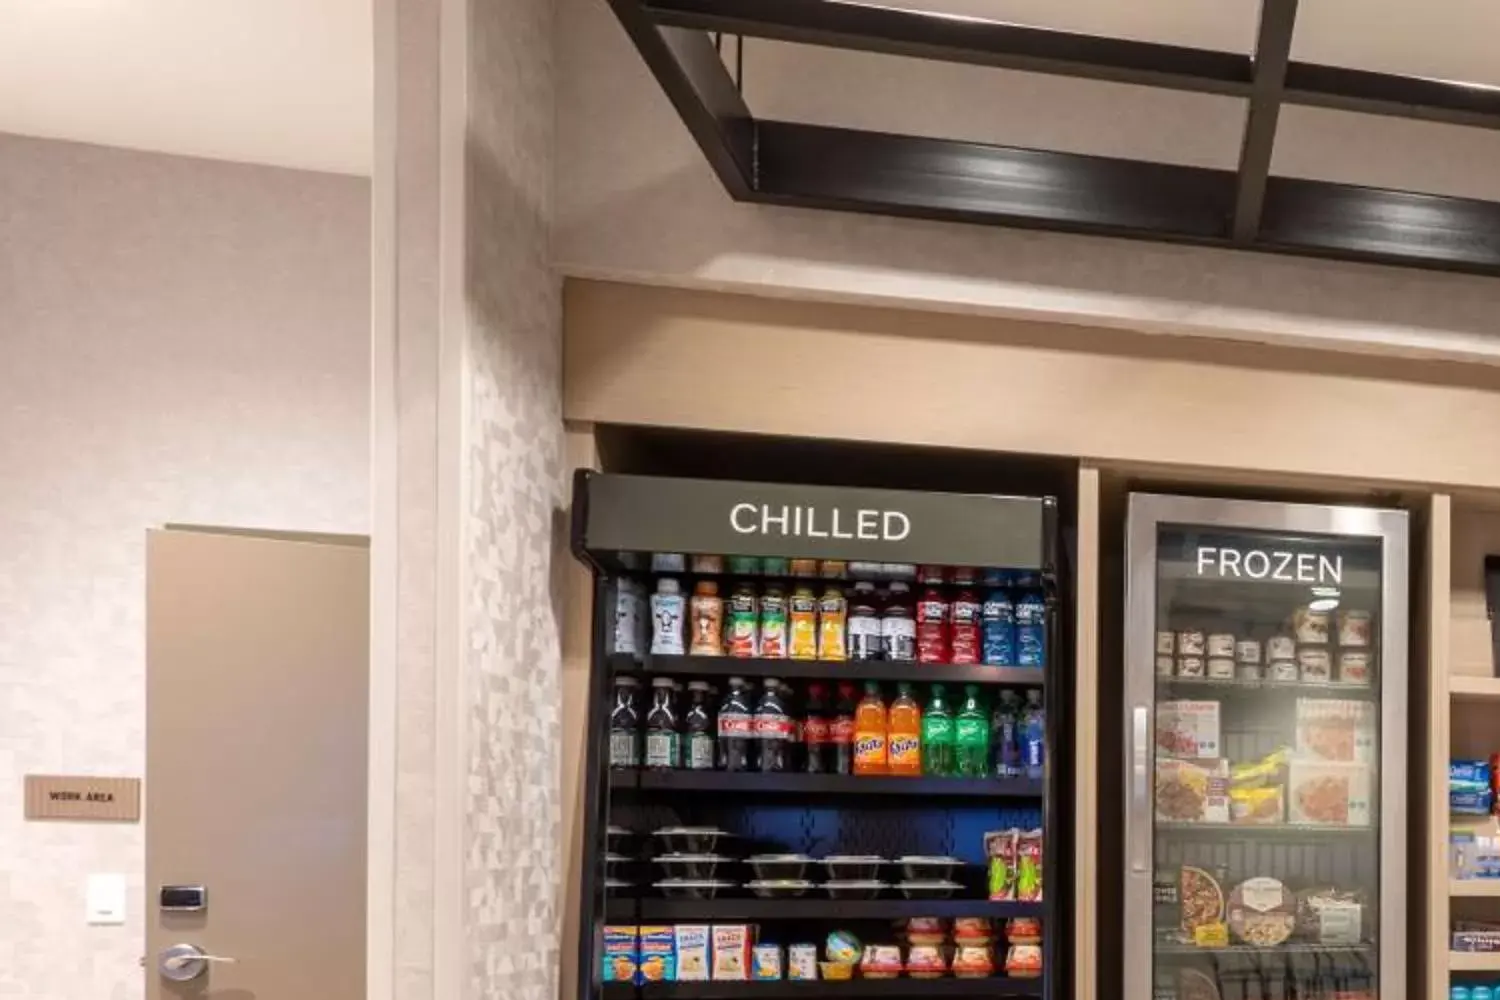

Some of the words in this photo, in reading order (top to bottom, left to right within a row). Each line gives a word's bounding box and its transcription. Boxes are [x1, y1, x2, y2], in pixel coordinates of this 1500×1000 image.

[729, 502, 911, 541] CHILLED
[1196, 546, 1343, 584] FROZEN
[49, 791, 82, 801] WORK
[86, 792, 115, 802] AREA
